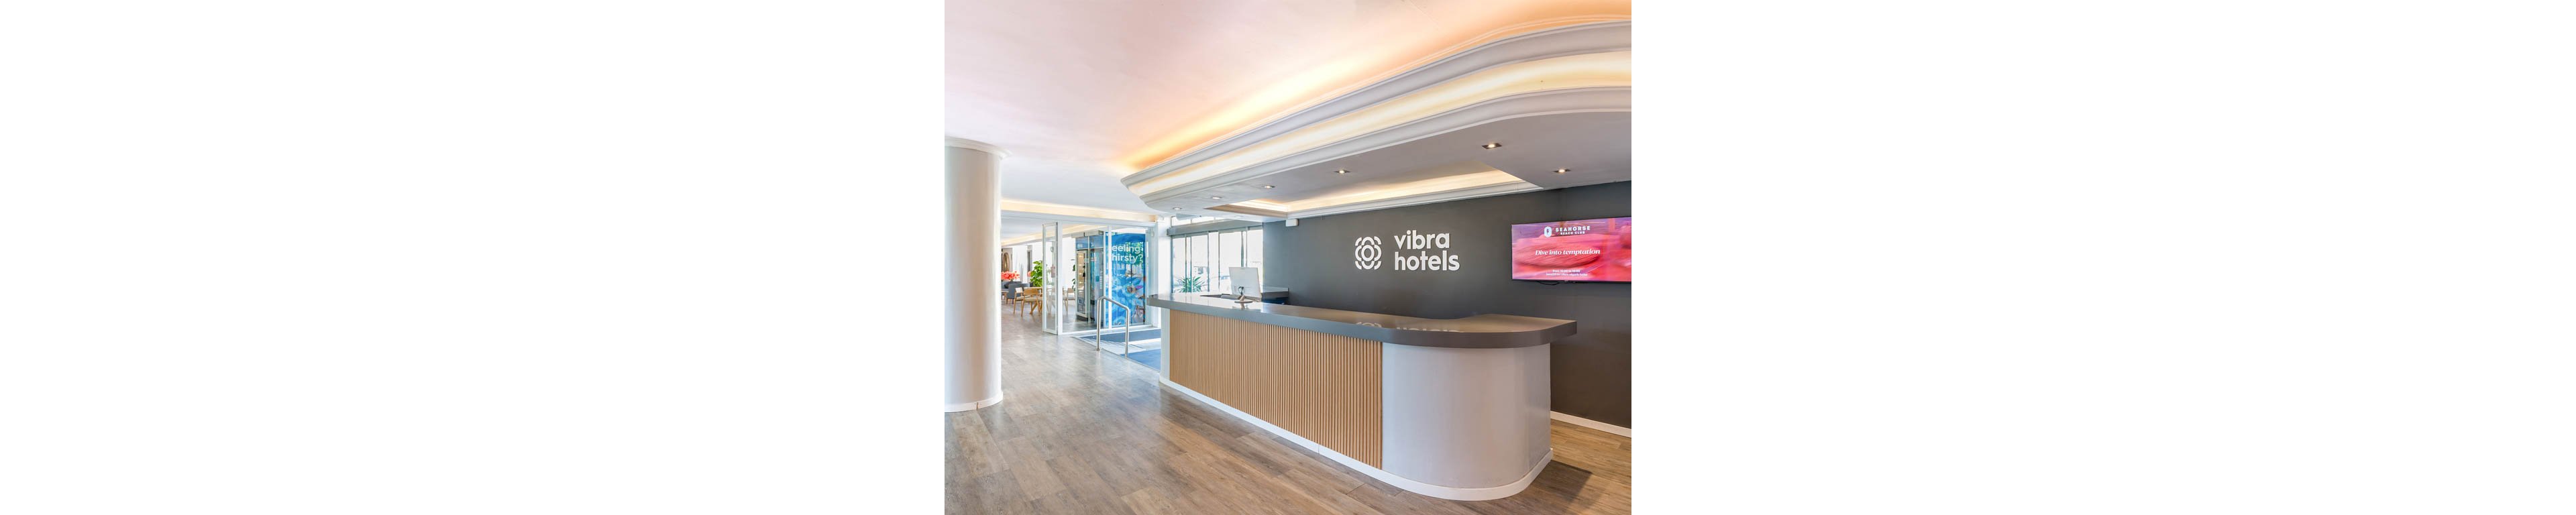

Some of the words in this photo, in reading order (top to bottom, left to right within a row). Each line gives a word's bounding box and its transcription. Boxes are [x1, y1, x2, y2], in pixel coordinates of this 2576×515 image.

[1394, 230, 1450, 249] vibra
[1112, 244, 1140, 254] eeling
[1112, 253, 1143, 262] hirsty?
[1395, 250, 1460, 271] hotels
